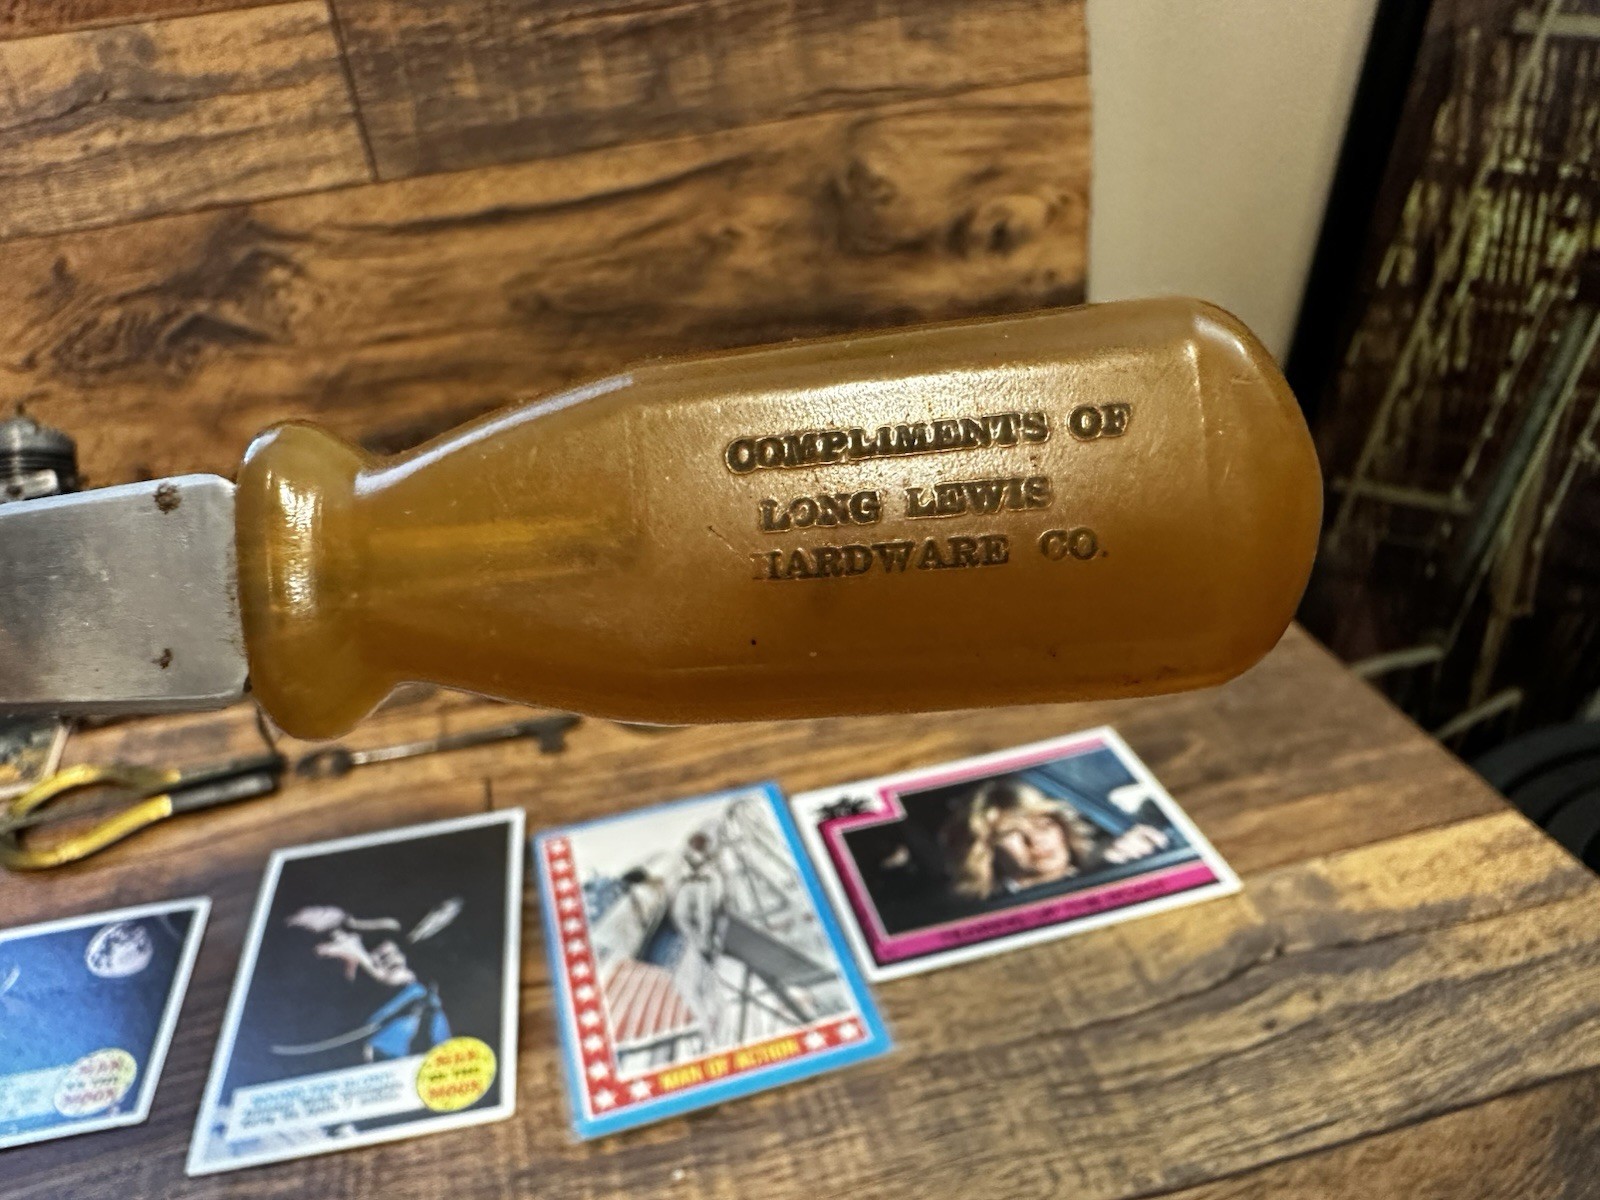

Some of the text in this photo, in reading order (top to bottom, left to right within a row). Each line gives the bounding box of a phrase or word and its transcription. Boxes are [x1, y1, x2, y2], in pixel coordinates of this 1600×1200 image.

[724, 403, 1132, 474] COMPLIMENTS OF
[759, 476, 1053, 533] LONG LEWIS
[1038, 526, 1110, 561] CO.
